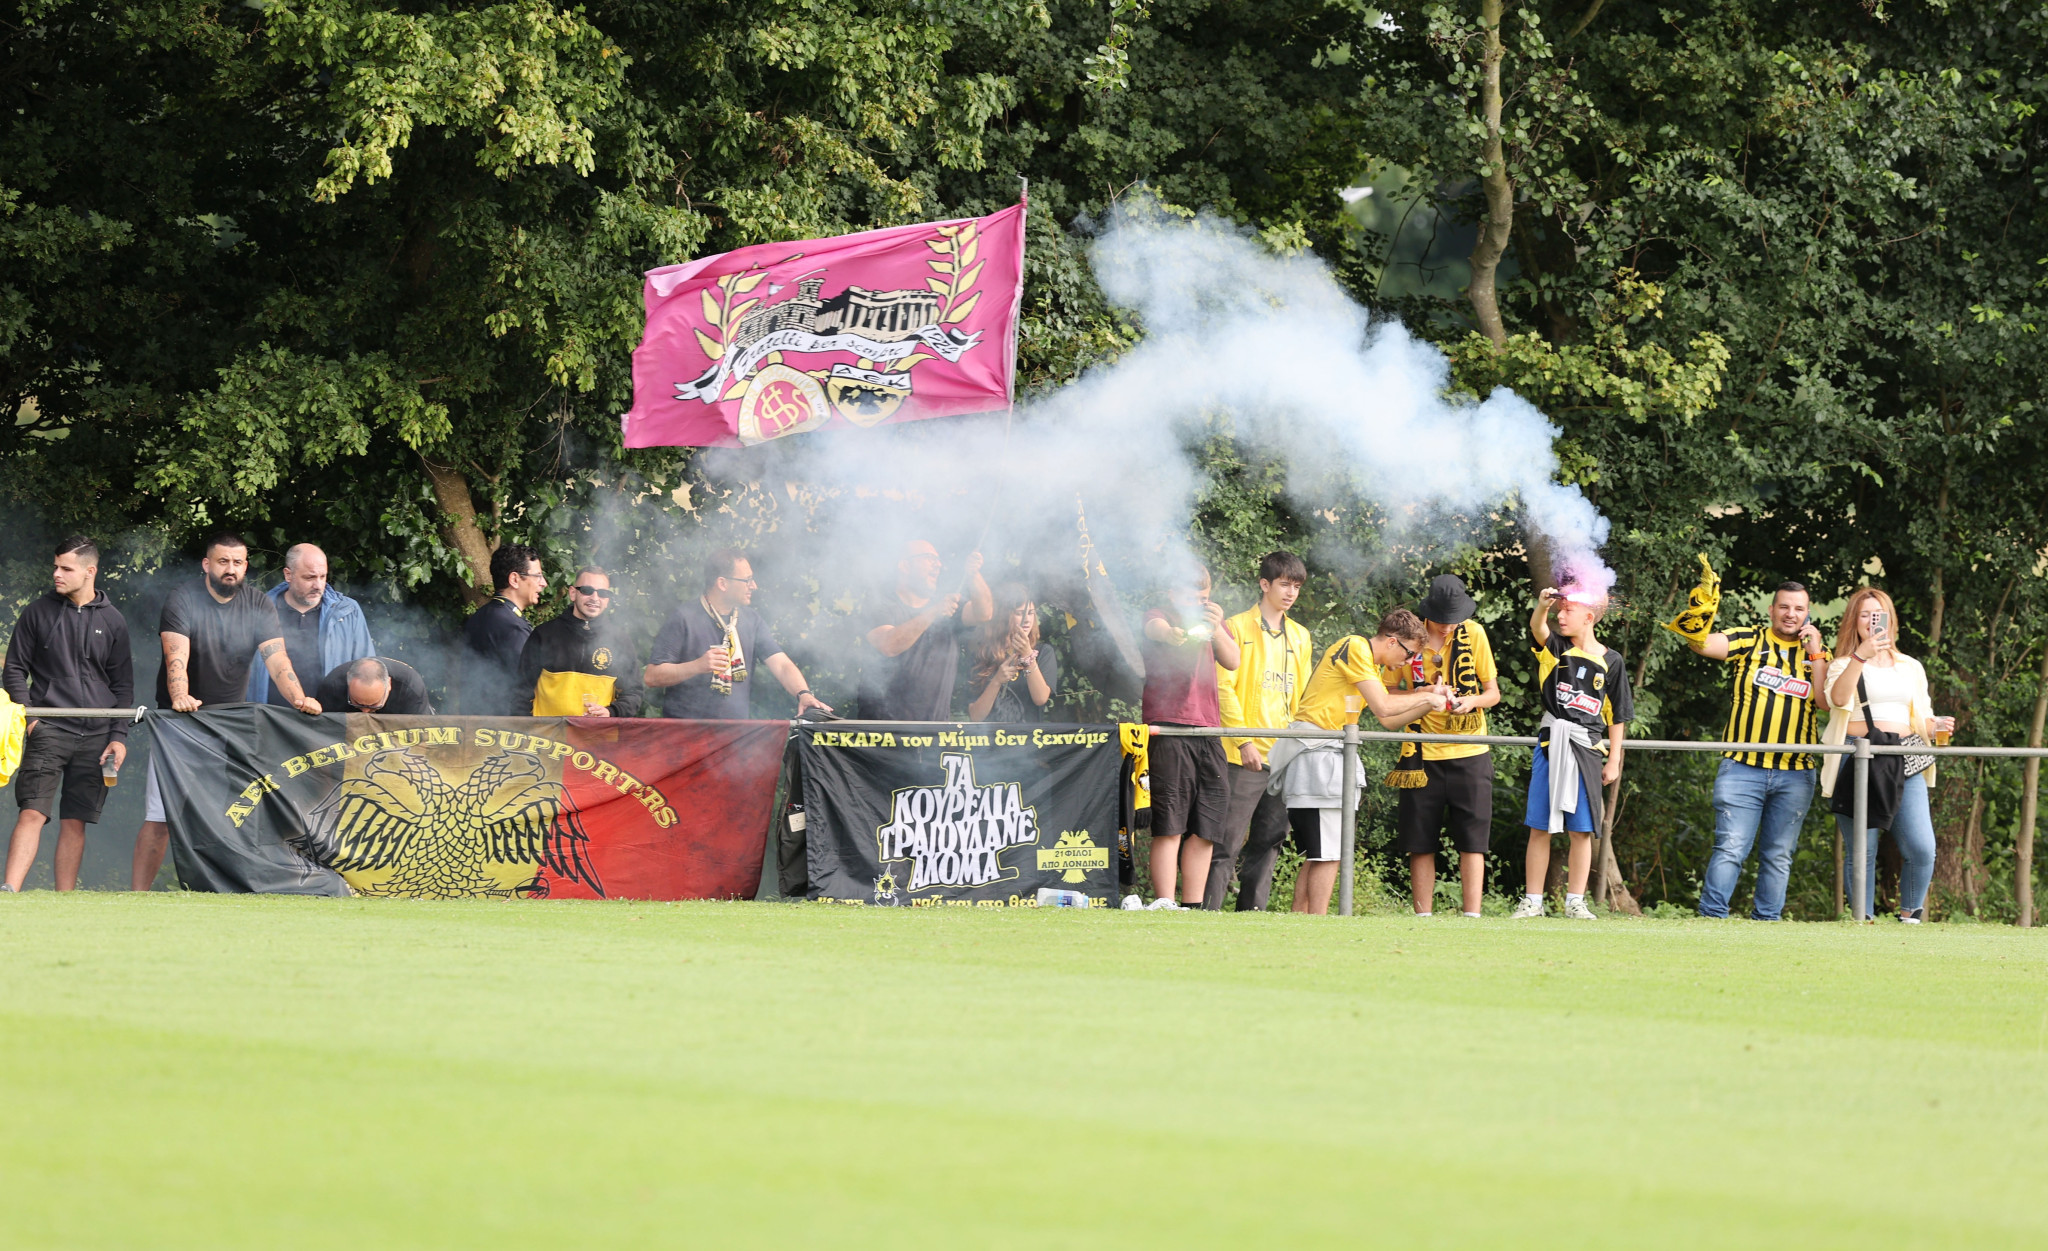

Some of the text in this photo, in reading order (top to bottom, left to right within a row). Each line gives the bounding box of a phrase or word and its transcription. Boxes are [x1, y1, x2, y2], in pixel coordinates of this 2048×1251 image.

[901, 737, 933, 747] τον
[938, 730, 990, 751] Μίμη
[995, 729, 1028, 746] δεν
[1032, 728, 1109, 749] ξεχνάμε
[225, 726, 679, 829] AEK BELGIUM SUPPORTERS
[943, 756, 975, 792] ΤΑ
[895, 784, 1021, 824] ΚΟΥΡΕΛΙΑ
[910, 850, 1000, 890] ΑΚΟΜΑ
[1041, 861, 1060, 869] ΑΠΟ
